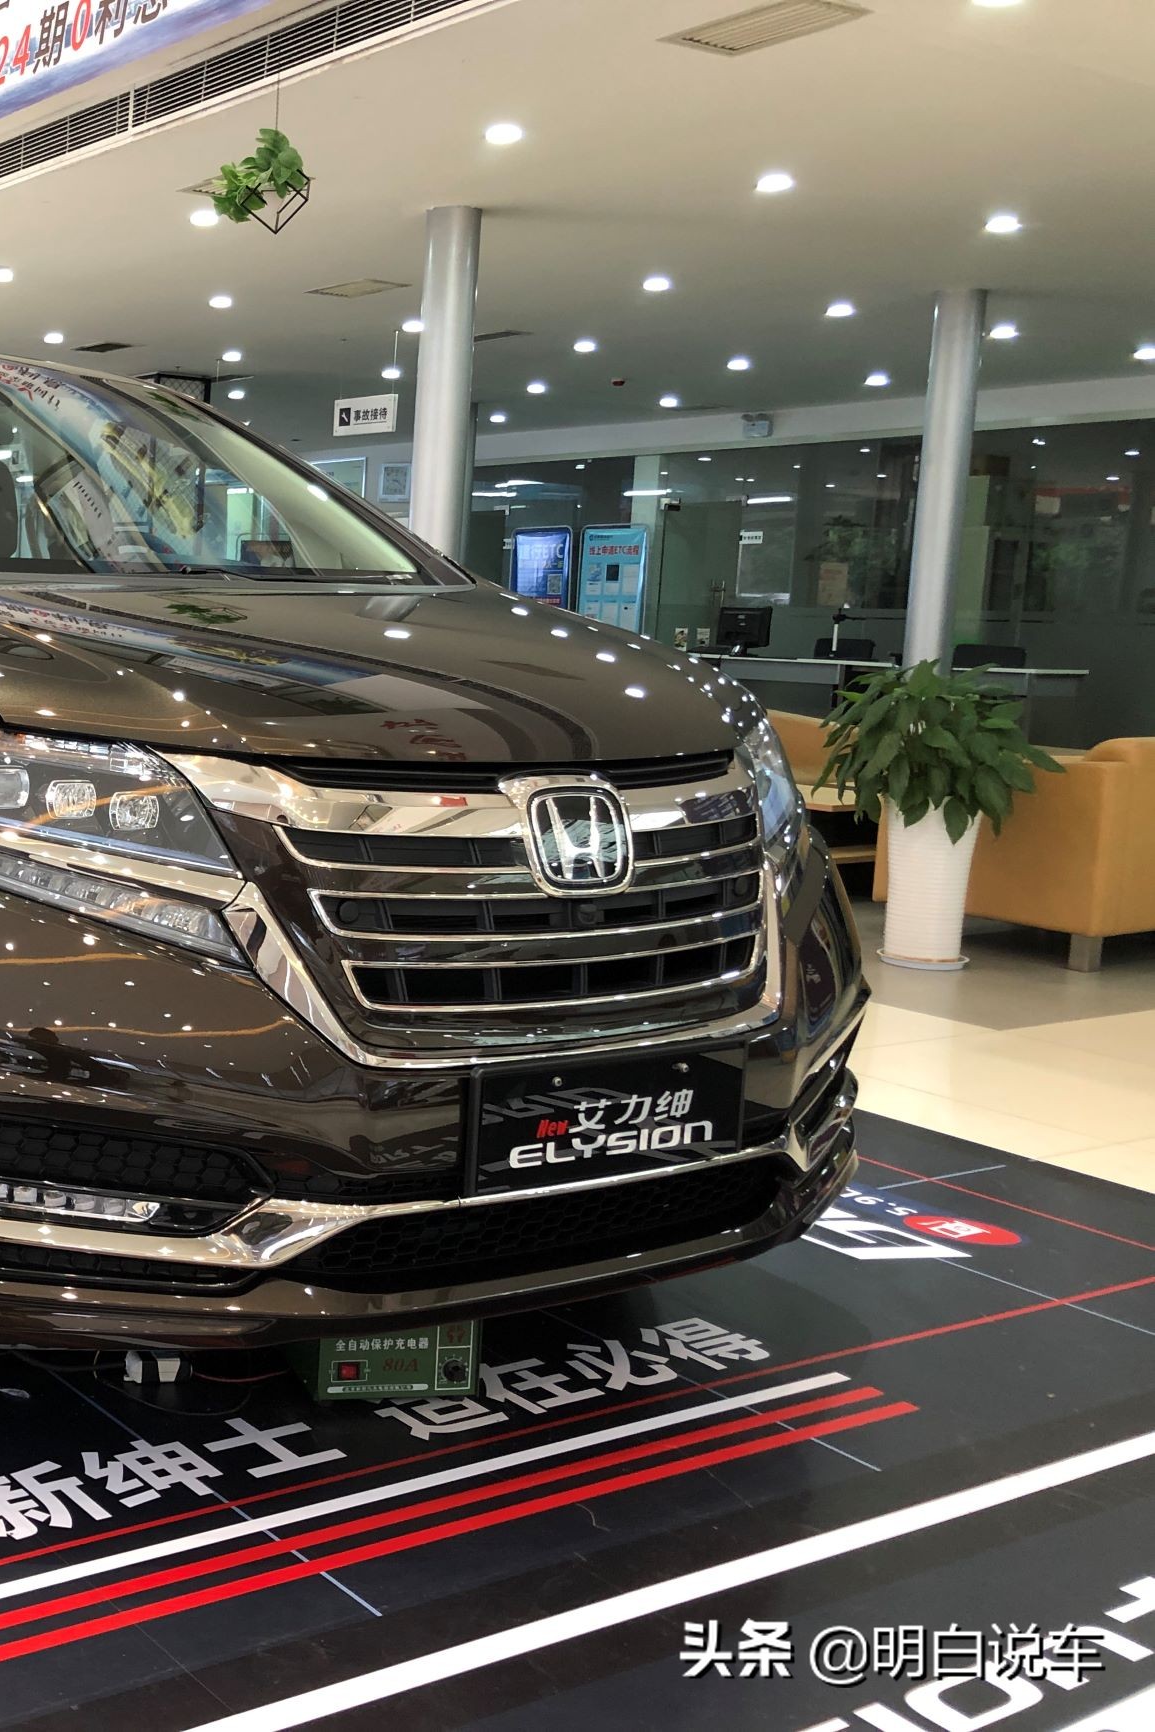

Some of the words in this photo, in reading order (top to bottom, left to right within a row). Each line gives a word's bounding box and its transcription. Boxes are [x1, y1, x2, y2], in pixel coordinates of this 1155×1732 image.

[353, 407, 388, 422] 事故接待
[569, 1088, 694, 1134] 艾力绅
[509, 1120, 713, 1169] ELYSION
[335, 1337, 429, 1352] 全自动保护充电器
[382, 1357, 419, 1373] 80A
